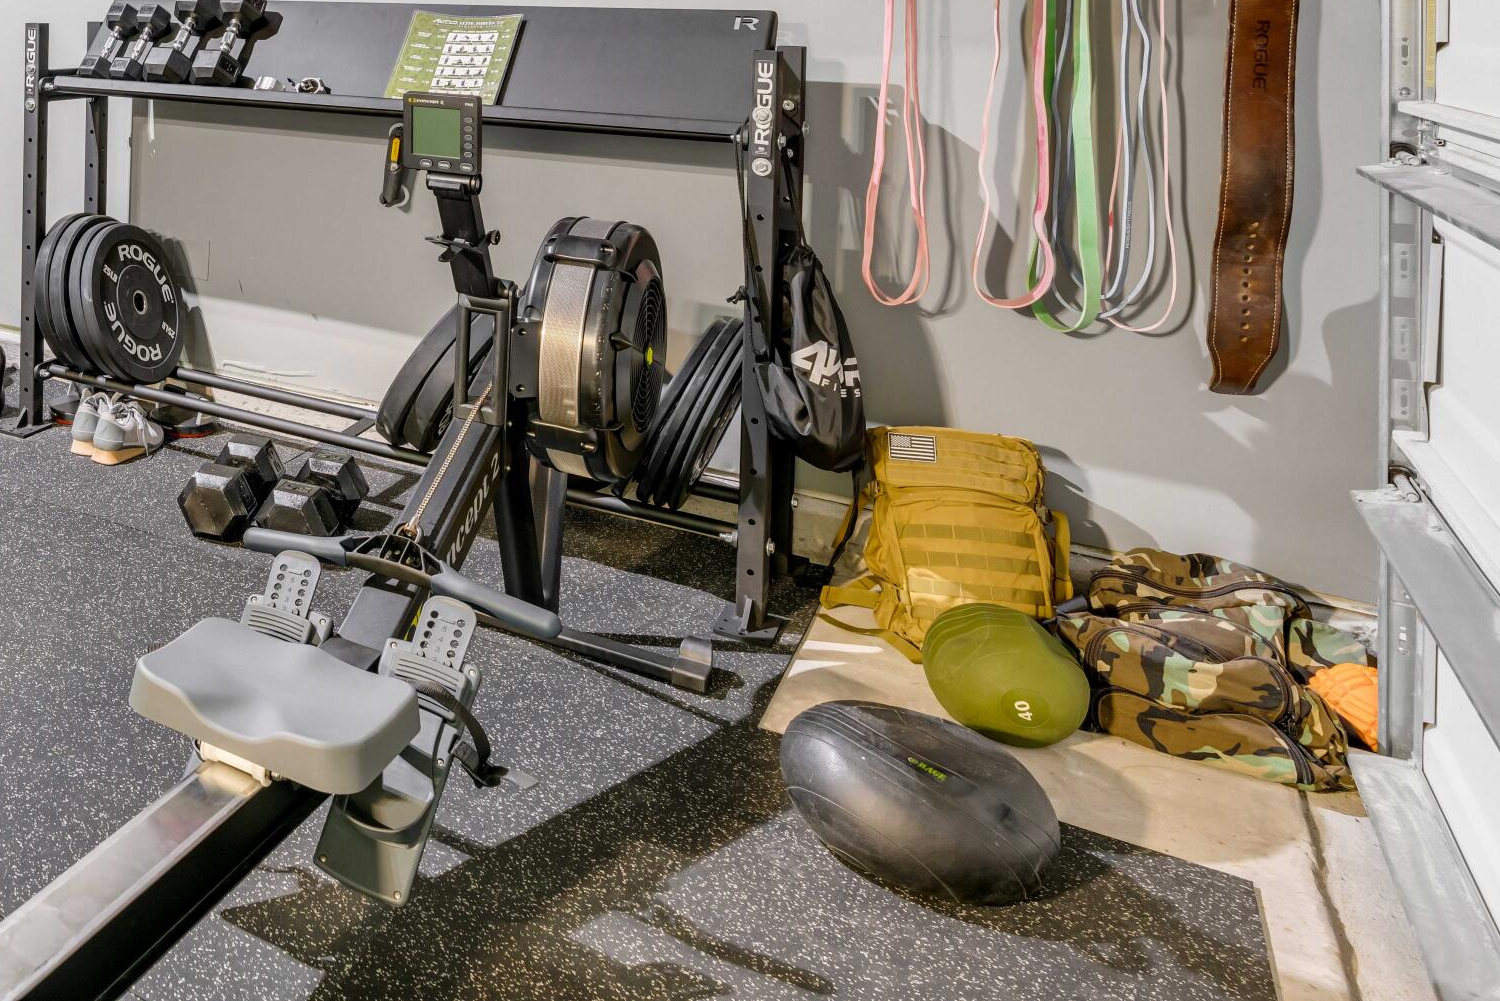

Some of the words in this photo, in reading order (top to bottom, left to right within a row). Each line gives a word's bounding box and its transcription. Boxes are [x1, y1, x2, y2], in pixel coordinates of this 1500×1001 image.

[1252, 19, 1271, 90] ROGUE
[118, 244, 174, 303] ROGUE
[104, 301, 162, 361] ROGUE
[446, 474, 490, 567] ncept
[490, 452, 500, 481] 2
[1014, 700, 1033, 722] 40
